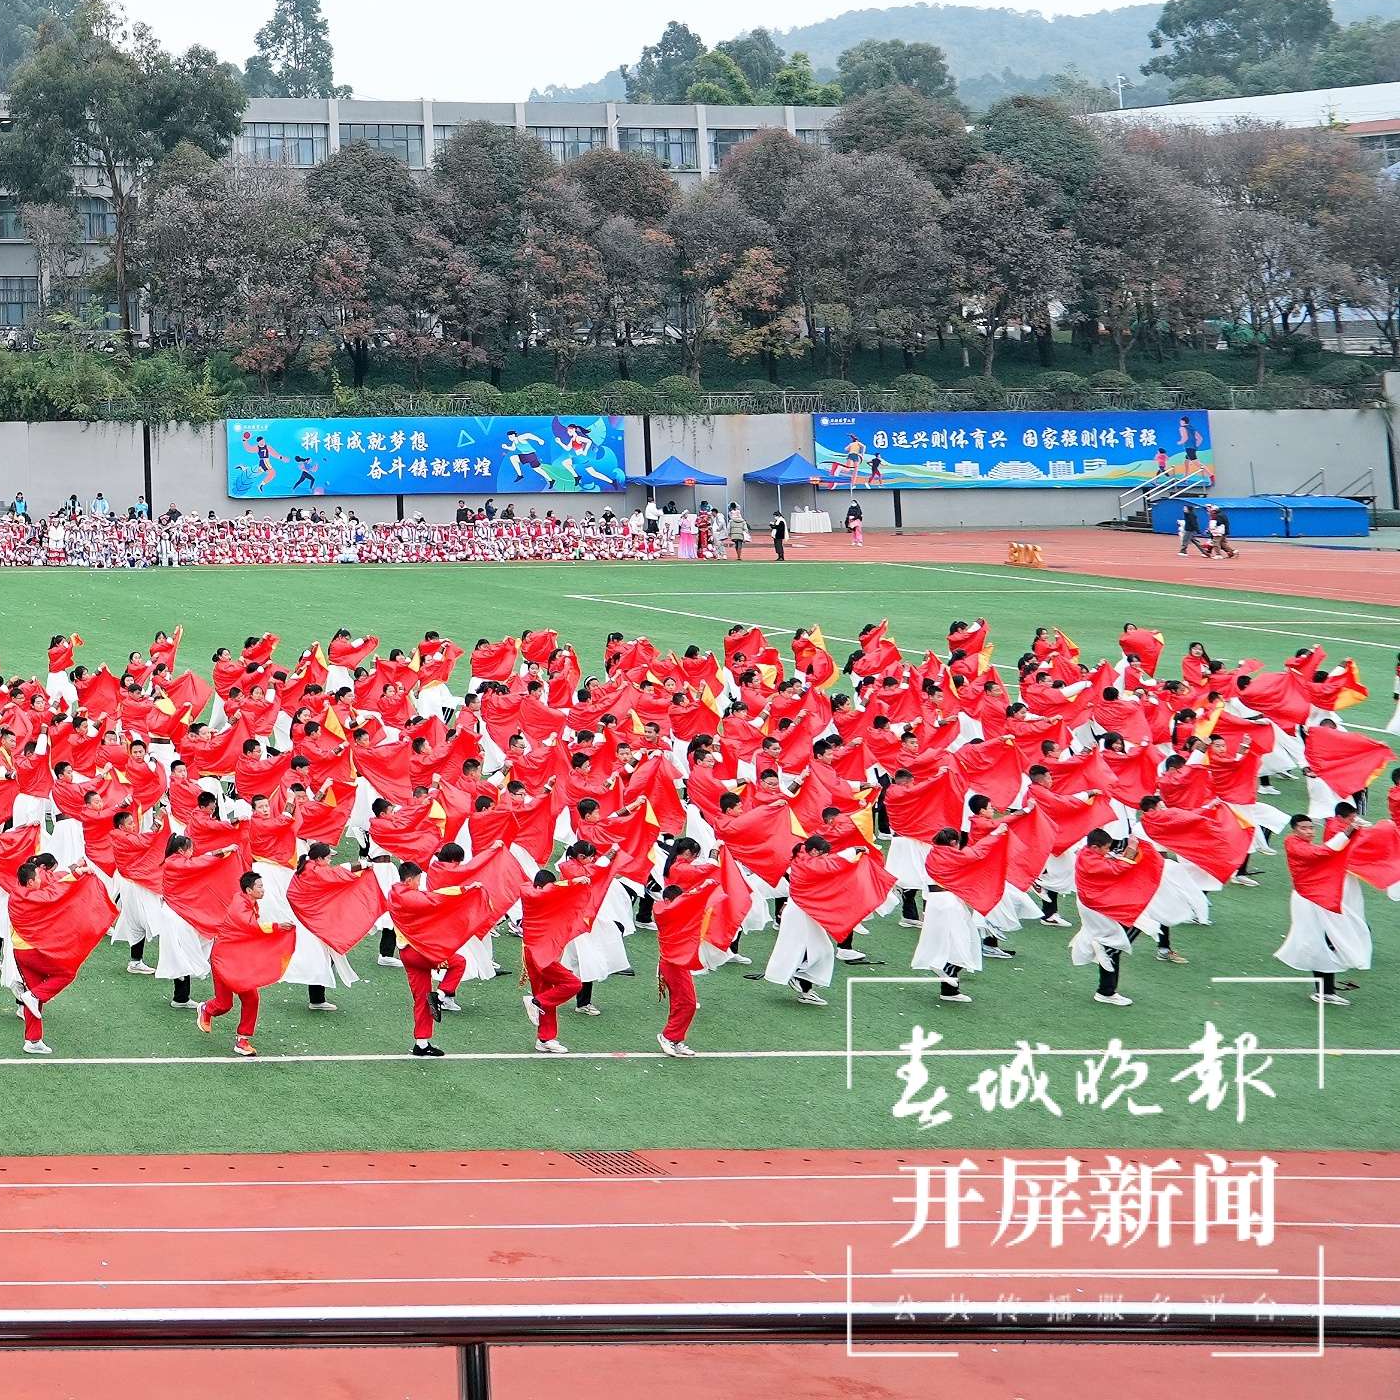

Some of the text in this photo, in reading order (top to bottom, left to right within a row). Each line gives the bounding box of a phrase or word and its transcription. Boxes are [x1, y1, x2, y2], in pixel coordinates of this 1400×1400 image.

[301, 430, 429, 453] 拼搏成就梦想
[872, 427, 1158, 450] 国运兴则体育兴 国家强则体育强
[367, 456, 493, 480] 奋斗铸就辉煌
